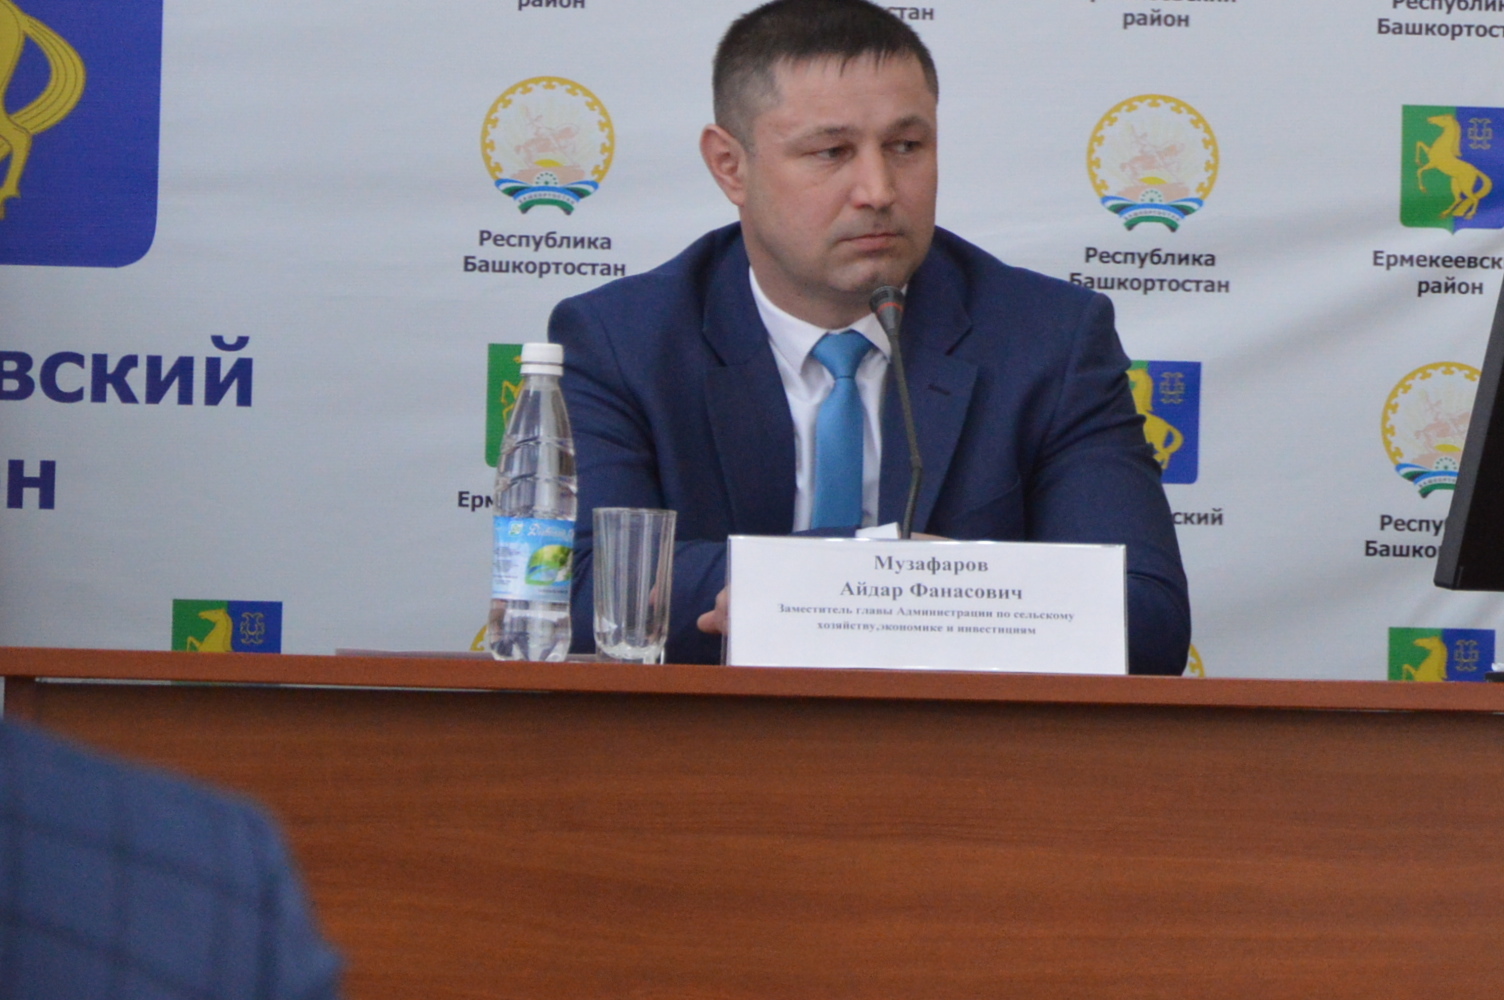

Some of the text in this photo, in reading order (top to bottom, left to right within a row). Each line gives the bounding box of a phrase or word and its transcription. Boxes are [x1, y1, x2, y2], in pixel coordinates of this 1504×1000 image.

[1123, 8, 1190, 30] район
[479, 229, 612, 252] Республика
[463, 255, 626, 279] Башкортостан
[1085, 246, 1216, 269] Республика
[1069, 272, 1230, 295] Башкортостан
[1417, 276, 1483, 298] район
[1364, 540, 1440, 559] Башко
[875, 554, 990, 576] Музафаров
[840, 581, 1024, 602] Айдар Фанасович
[778, 603, 1075, 622] Заместитель главы Администрации по сельскому
[957, 625, 1037, 636] инвестициям
